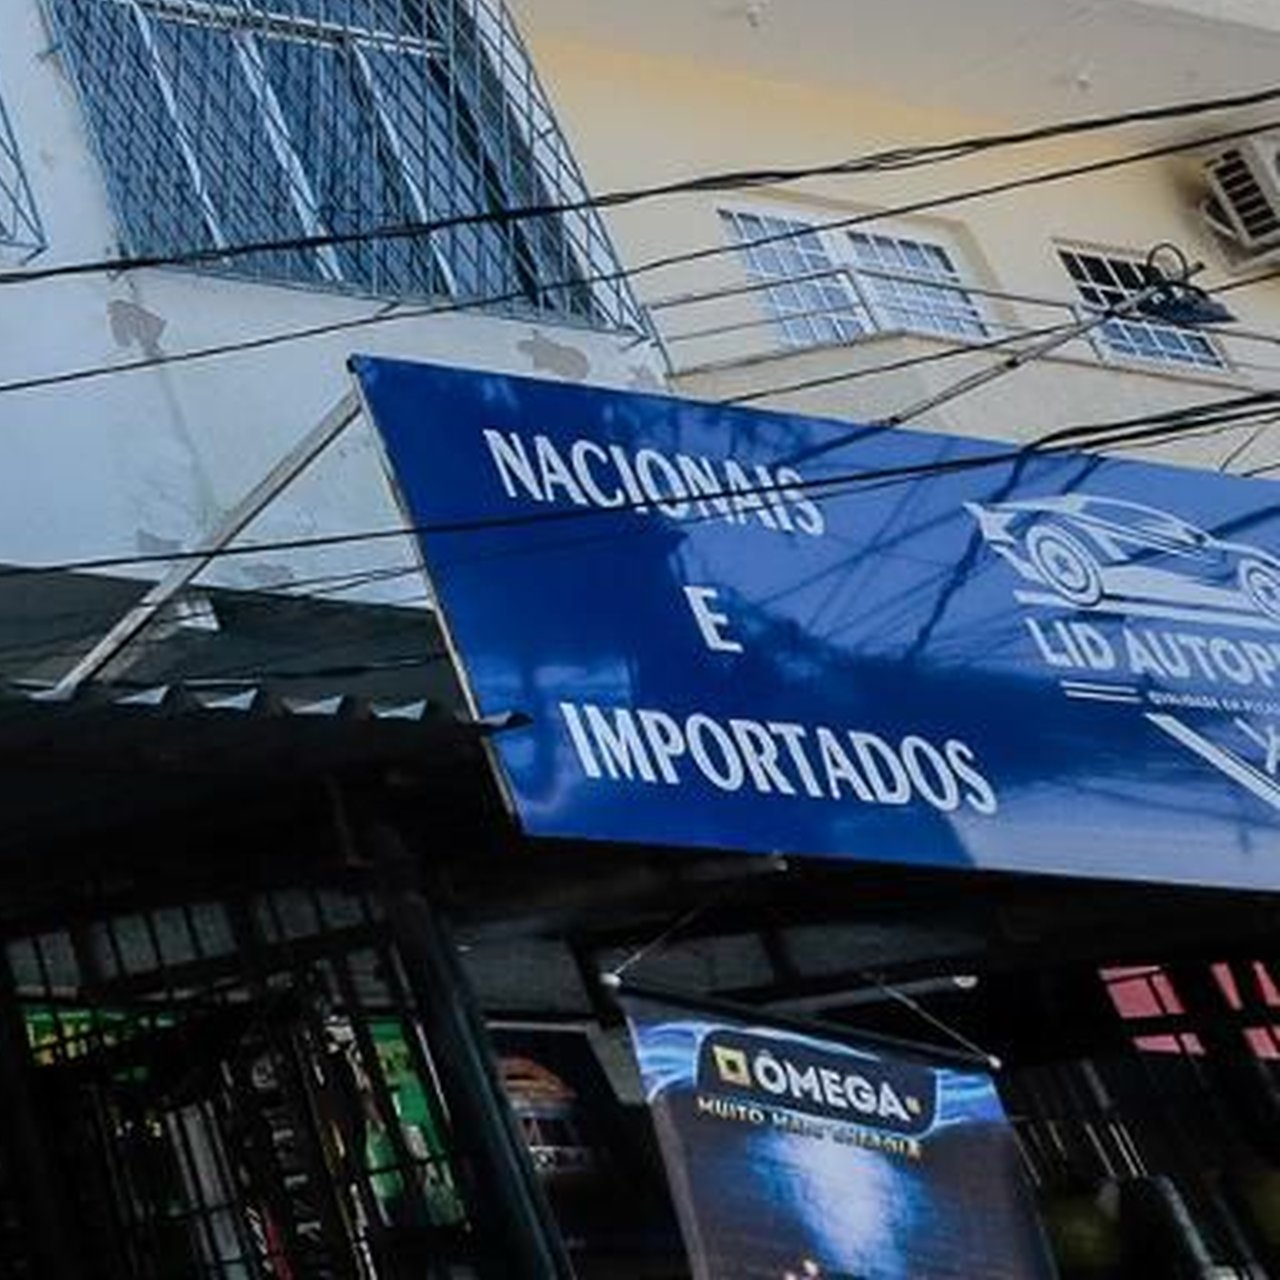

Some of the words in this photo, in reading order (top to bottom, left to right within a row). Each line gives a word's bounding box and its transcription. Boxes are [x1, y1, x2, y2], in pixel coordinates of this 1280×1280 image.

[482, 428, 826, 536] NACIONAIS
[683, 586, 744, 653] E
[1026, 617, 1116, 672] LID
[560, 700, 998, 815] IMPORTADOS
